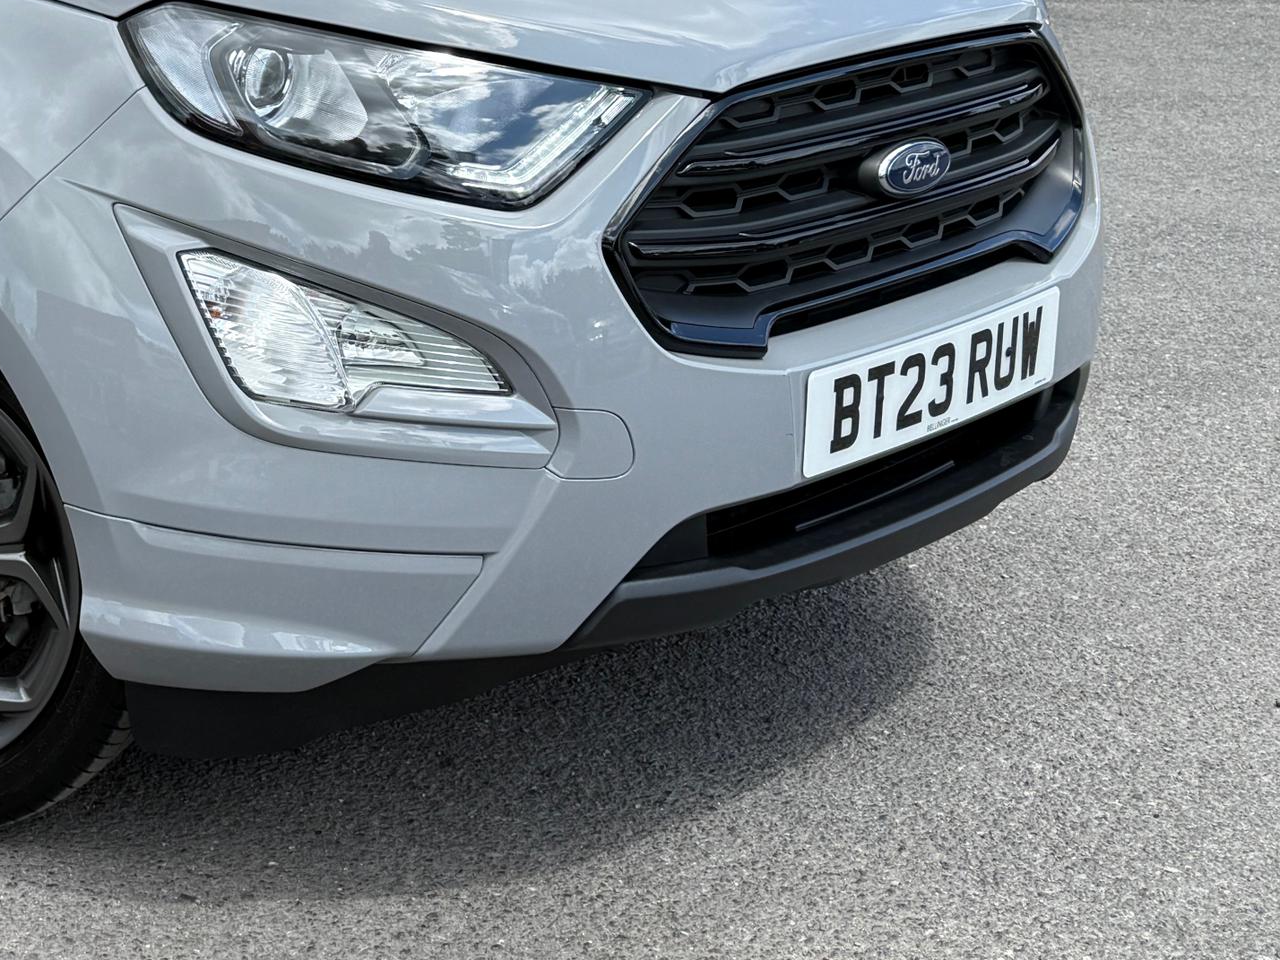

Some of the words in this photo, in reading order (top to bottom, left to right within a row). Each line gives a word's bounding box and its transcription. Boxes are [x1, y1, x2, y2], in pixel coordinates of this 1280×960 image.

[902, 150, 940, 184] Ford
[829, 342, 956, 454] BT23
[966, 306, 1043, 404] RUW
